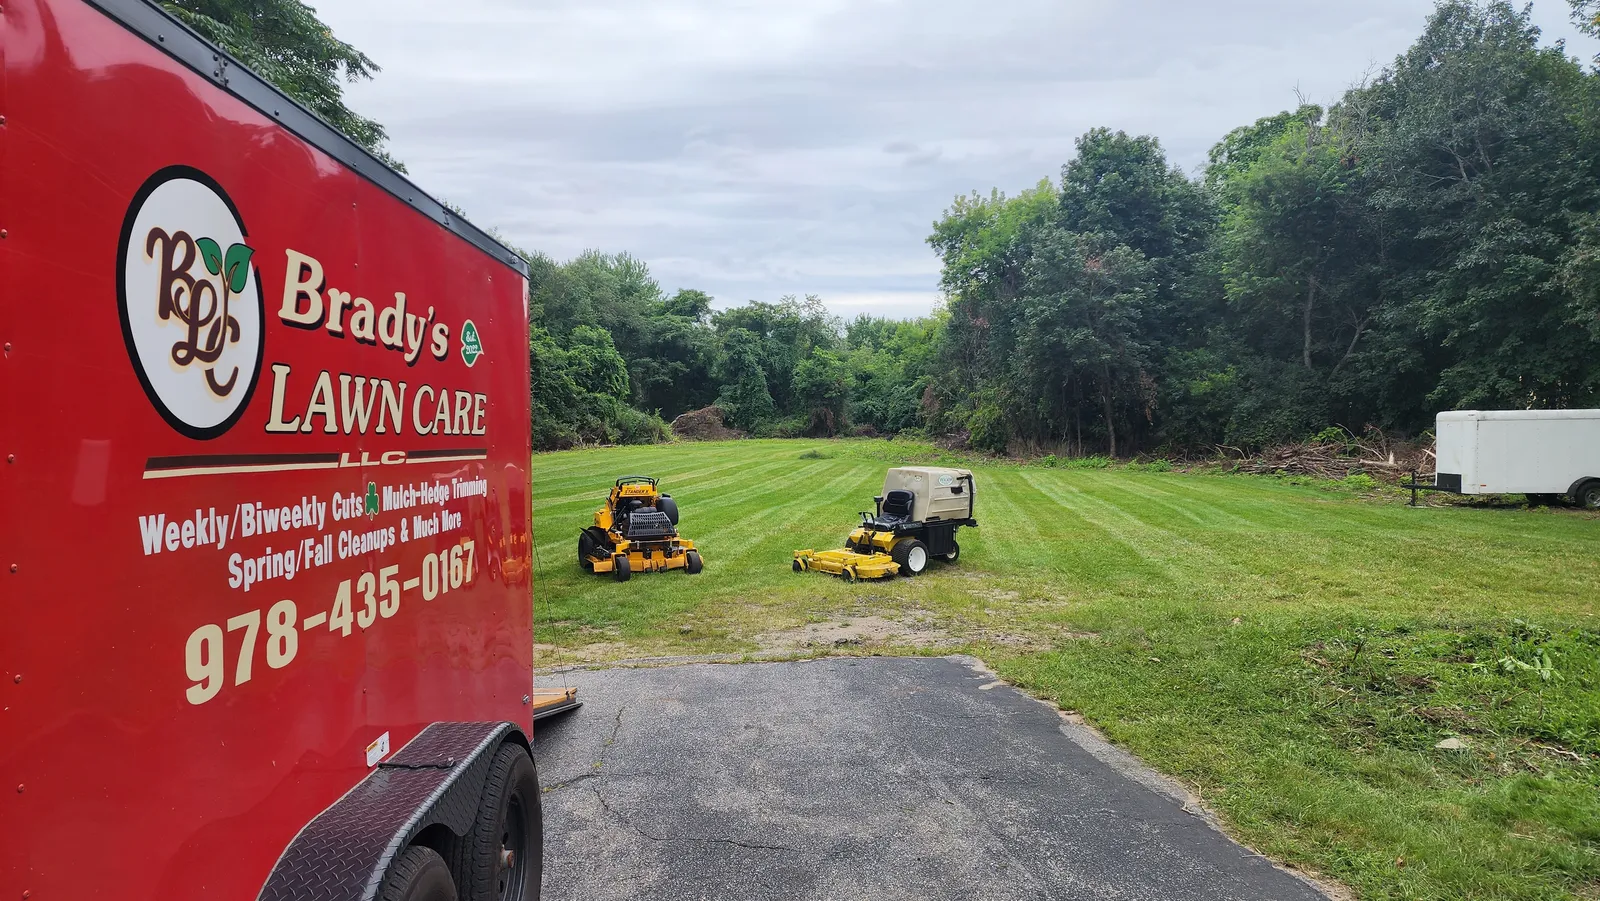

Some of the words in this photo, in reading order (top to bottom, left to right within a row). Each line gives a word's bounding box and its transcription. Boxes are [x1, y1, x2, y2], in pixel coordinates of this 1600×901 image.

[278, 248, 450, 365] Brady's
[465, 344, 478, 355] 2022
[265, 364, 407, 435] LAWN
[412, 384, 488, 435] CARE
[339, 450, 407, 468] LLC
[138, 492, 327, 556] Weekly/Biweekly
[332, 492, 363, 522] Cuts
[382, 482, 450, 512] Mulch-Hedge
[451, 475, 488, 500] Trimming
[228, 534, 333, 593] Spring/Fall
[337, 526, 396, 561] Cleanups
[399, 518, 409, 543] &
[413, 513, 439, 540] Much
[441, 509, 462, 533] More
[185, 540, 476, 706] 978-435-0167
